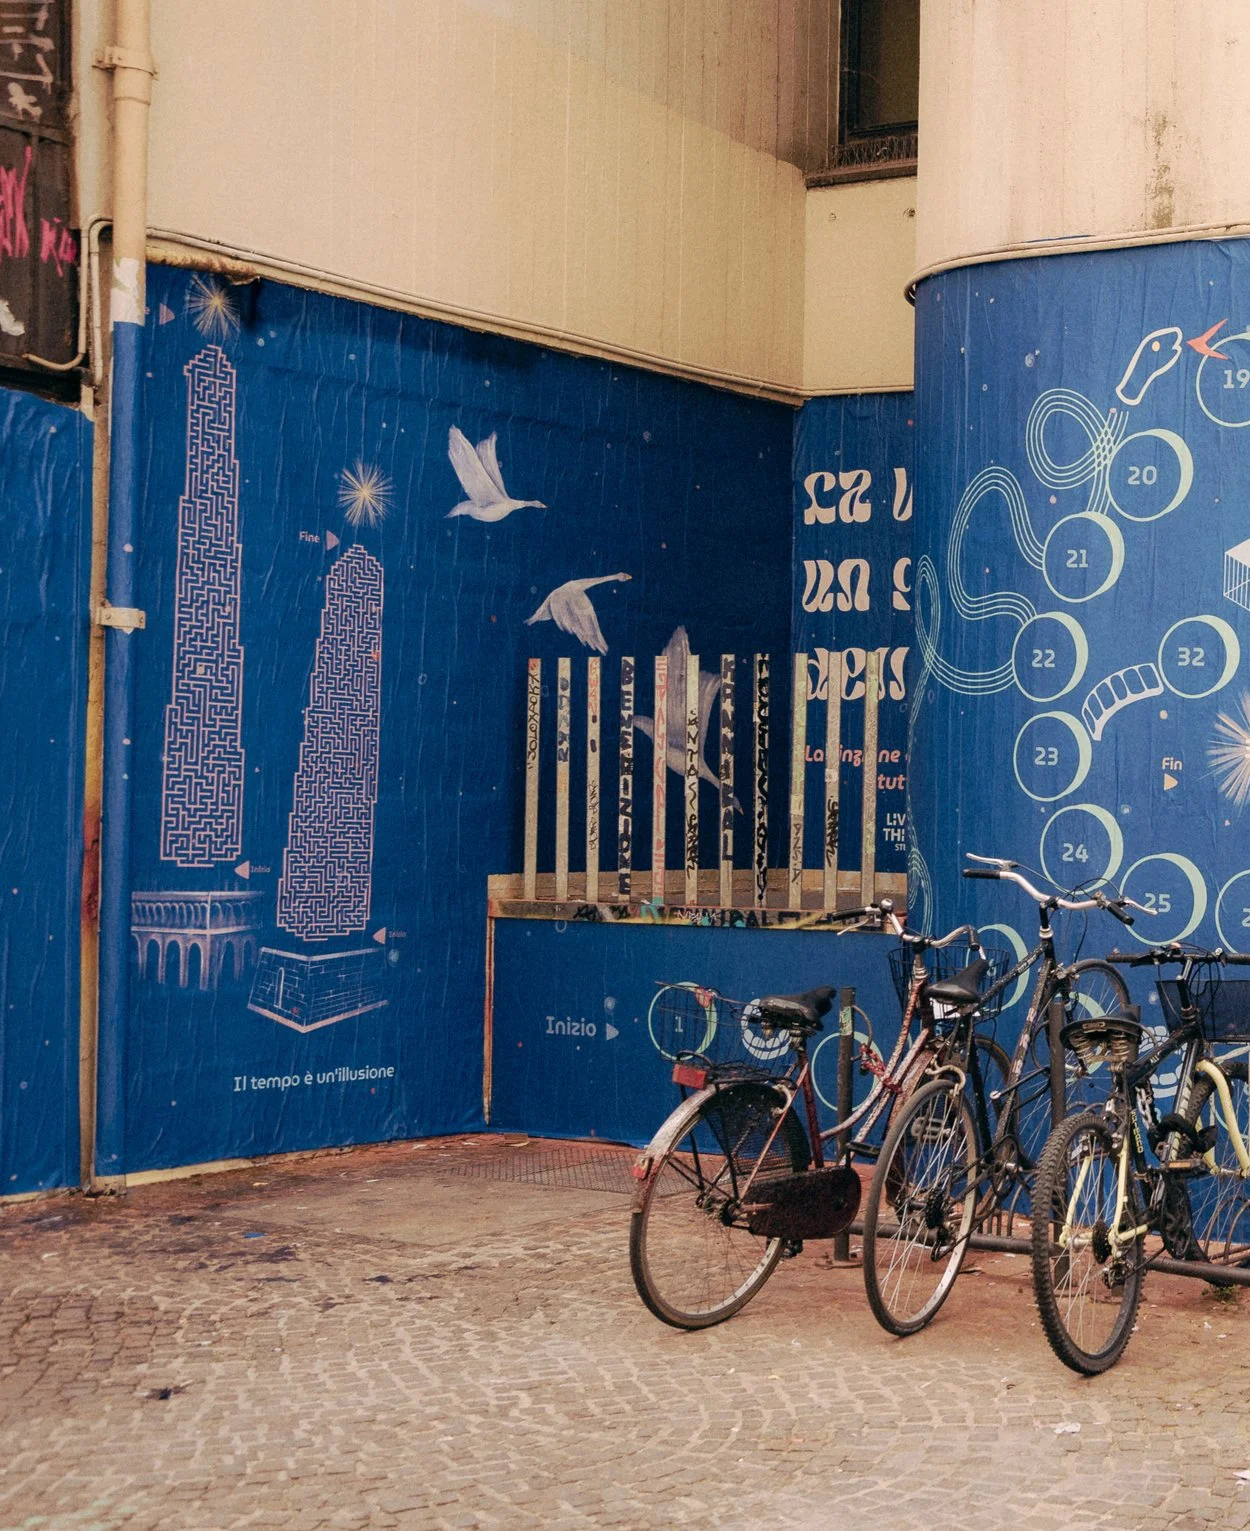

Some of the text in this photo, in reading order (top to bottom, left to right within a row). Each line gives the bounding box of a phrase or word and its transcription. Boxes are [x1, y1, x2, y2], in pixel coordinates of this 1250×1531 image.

[1223, 369, 1250, 390] 19
[1128, 467, 1157, 485] 20
[299, 531, 321, 543] Fine
[1066, 550, 1089, 568] 21
[802, 558, 870, 613] un
[1031, 649, 1056, 668] 22
[1177, 647, 1205, 667] 32
[805, 745, 824, 763] La
[1034, 746, 1059, 766] 23
[1162, 757, 1182, 770] Fin
[1062, 843, 1089, 864] 24
[1145, 893, 1171, 913] 25
[546, 1015, 684, 1037] Inizio 1
[233, 1065, 395, 1092] Il tempo è un'illusione
